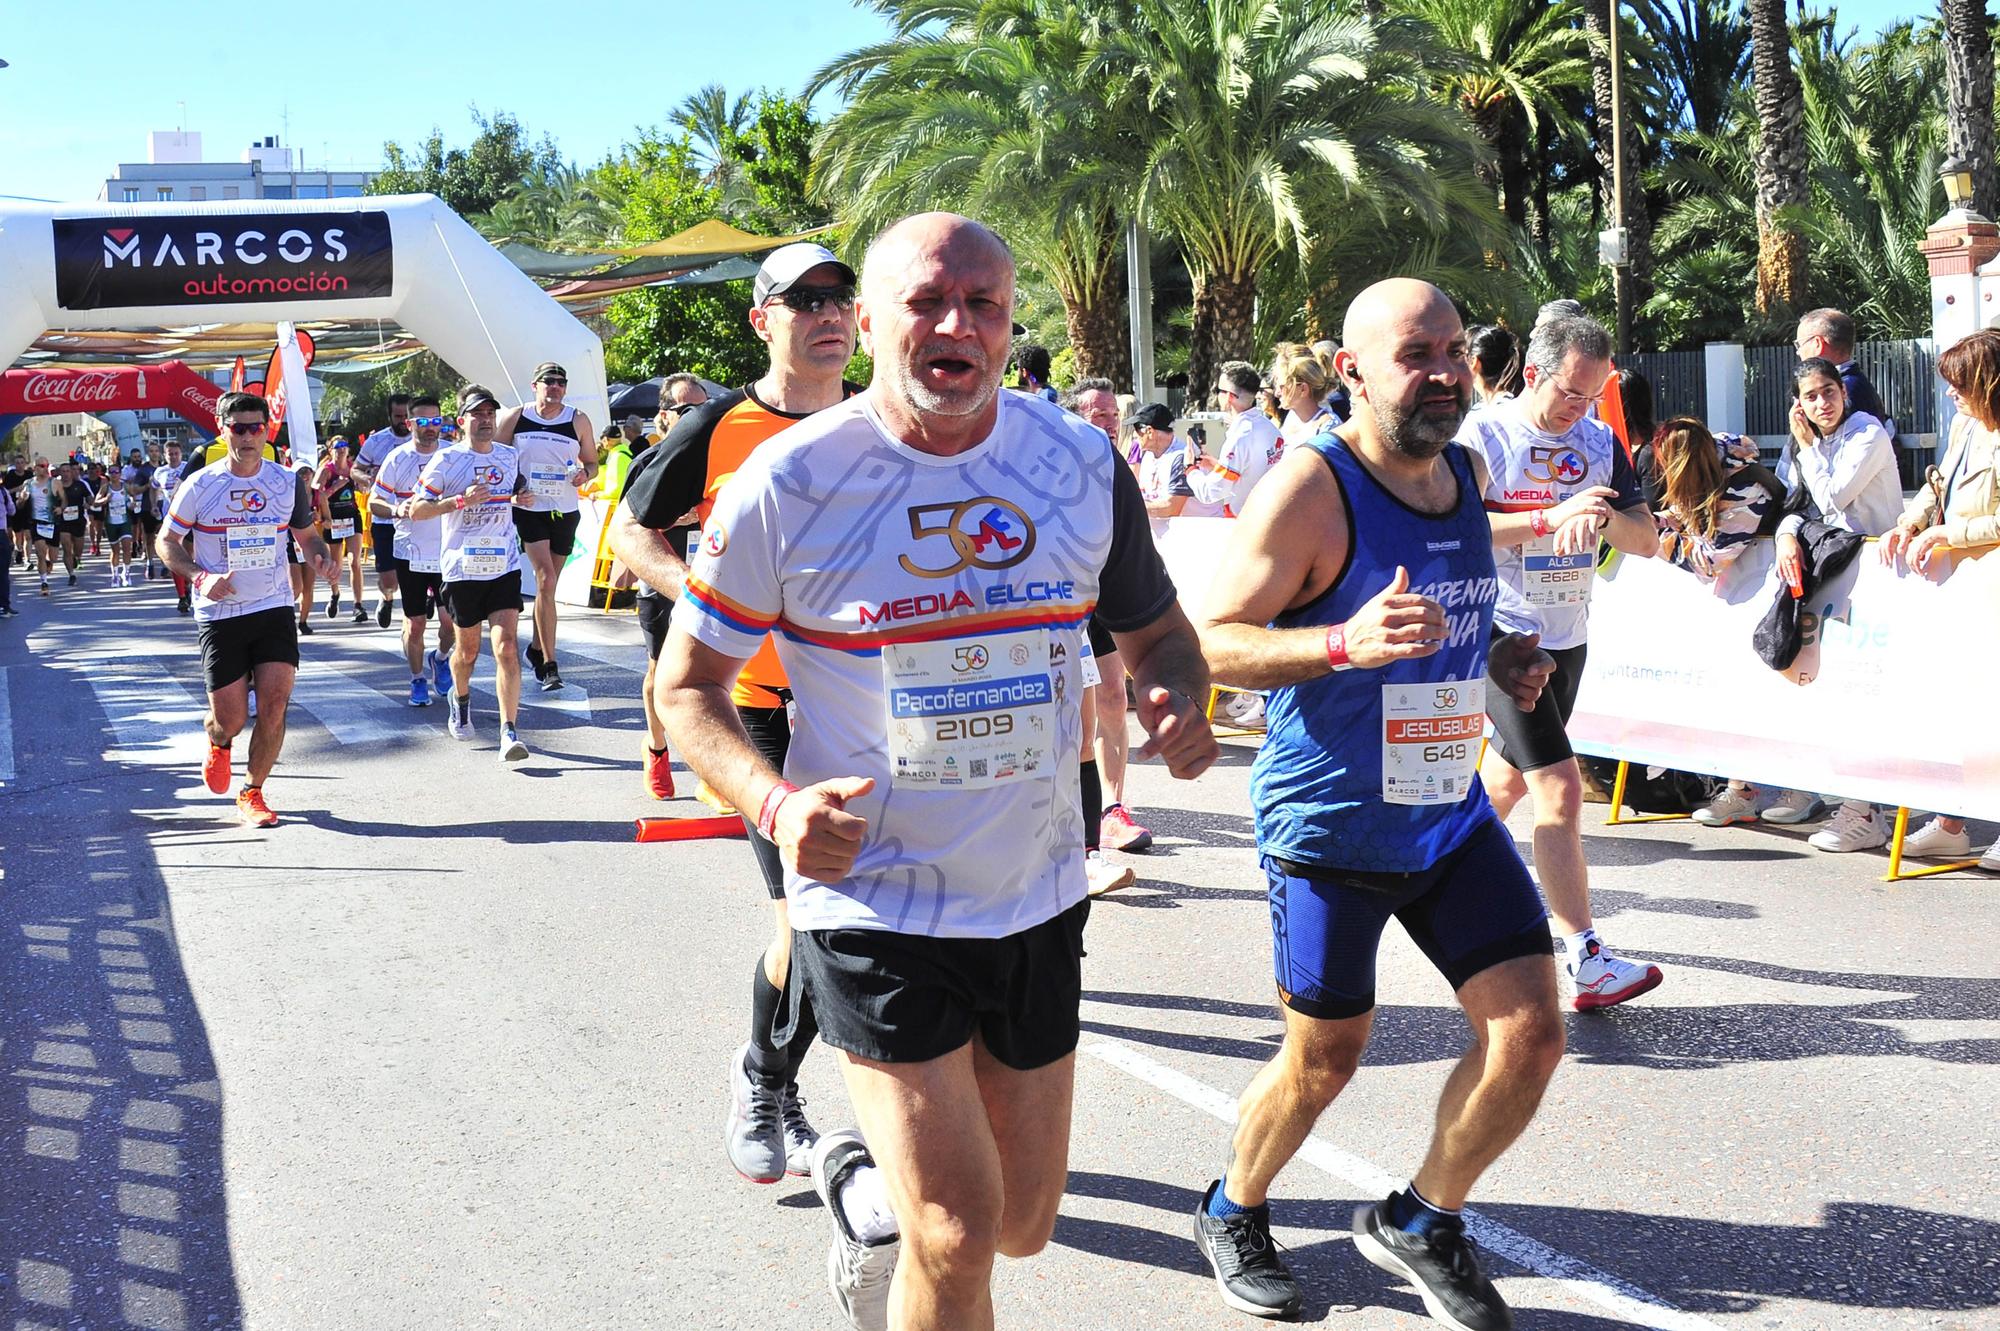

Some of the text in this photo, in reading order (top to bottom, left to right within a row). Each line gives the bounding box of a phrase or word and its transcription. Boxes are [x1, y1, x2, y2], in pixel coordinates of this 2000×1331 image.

[103, 229, 347, 268] MARCOS
[183, 272, 347, 296] automoción
[23, 371, 117, 403] Coca-Cola
[1524, 446, 1588, 485] 50
[226, 489, 267, 513] 50
[1503, 490, 1553, 500] MEDIA
[213, 516, 280, 525] MEDIA ELCHE
[240, 538, 265, 547] QUILES
[898, 496, 1036, 579] 50
[1547, 556, 1575, 568] ALEX
[1541, 571, 1579, 583] 2628
[859, 581, 1075, 626] MEDIA ELCHE
[951, 644, 989, 673] 50
[896, 680, 1046, 712] Pacofernandez
[1433, 688, 1458, 709] 50
[936, 714, 1014, 741] 2109
[1394, 716, 1480, 738] JESUSBLAS
[1423, 744, 1466, 762] 649
